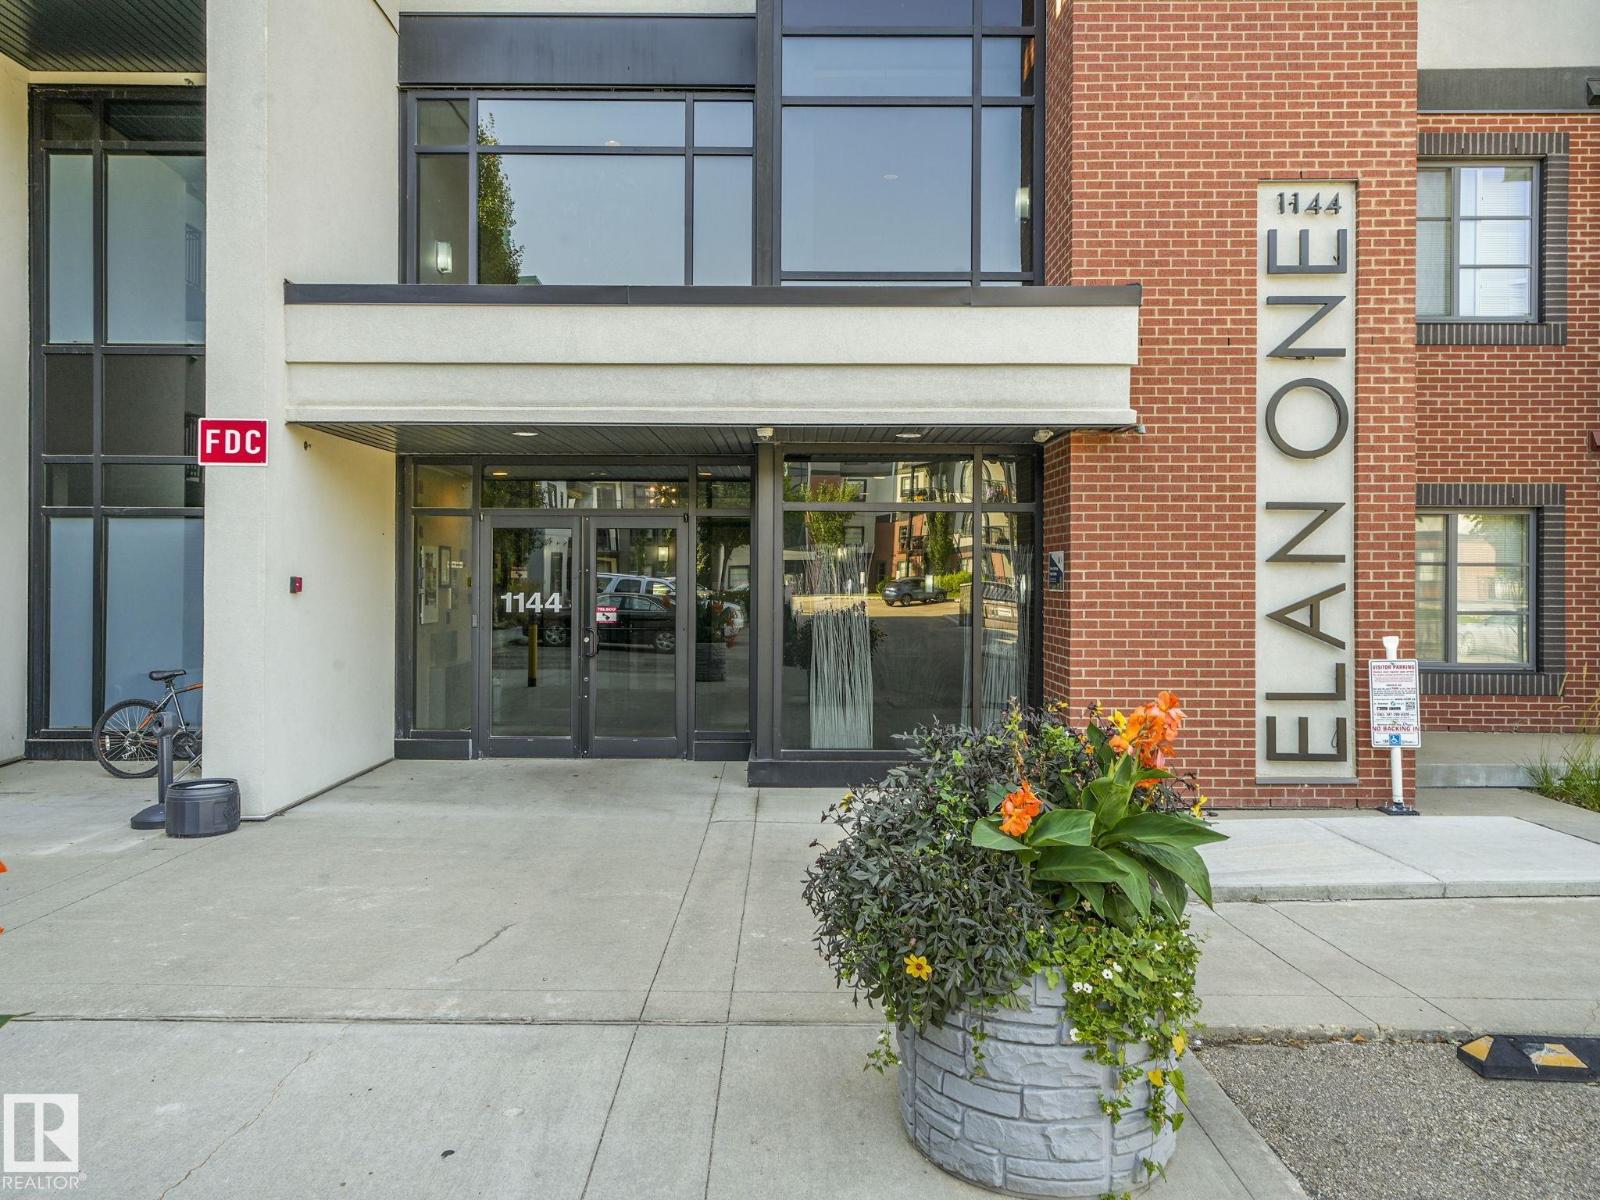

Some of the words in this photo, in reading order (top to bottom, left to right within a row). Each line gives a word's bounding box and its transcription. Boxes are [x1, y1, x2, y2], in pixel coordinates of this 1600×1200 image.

[1276, 191, 1342, 215] 1144
[1265, 228, 1349, 460] ONE
[205, 429, 261, 455] FDC
[500, 592, 563, 613] 1144
[1265, 501, 1347, 762] ELAN
